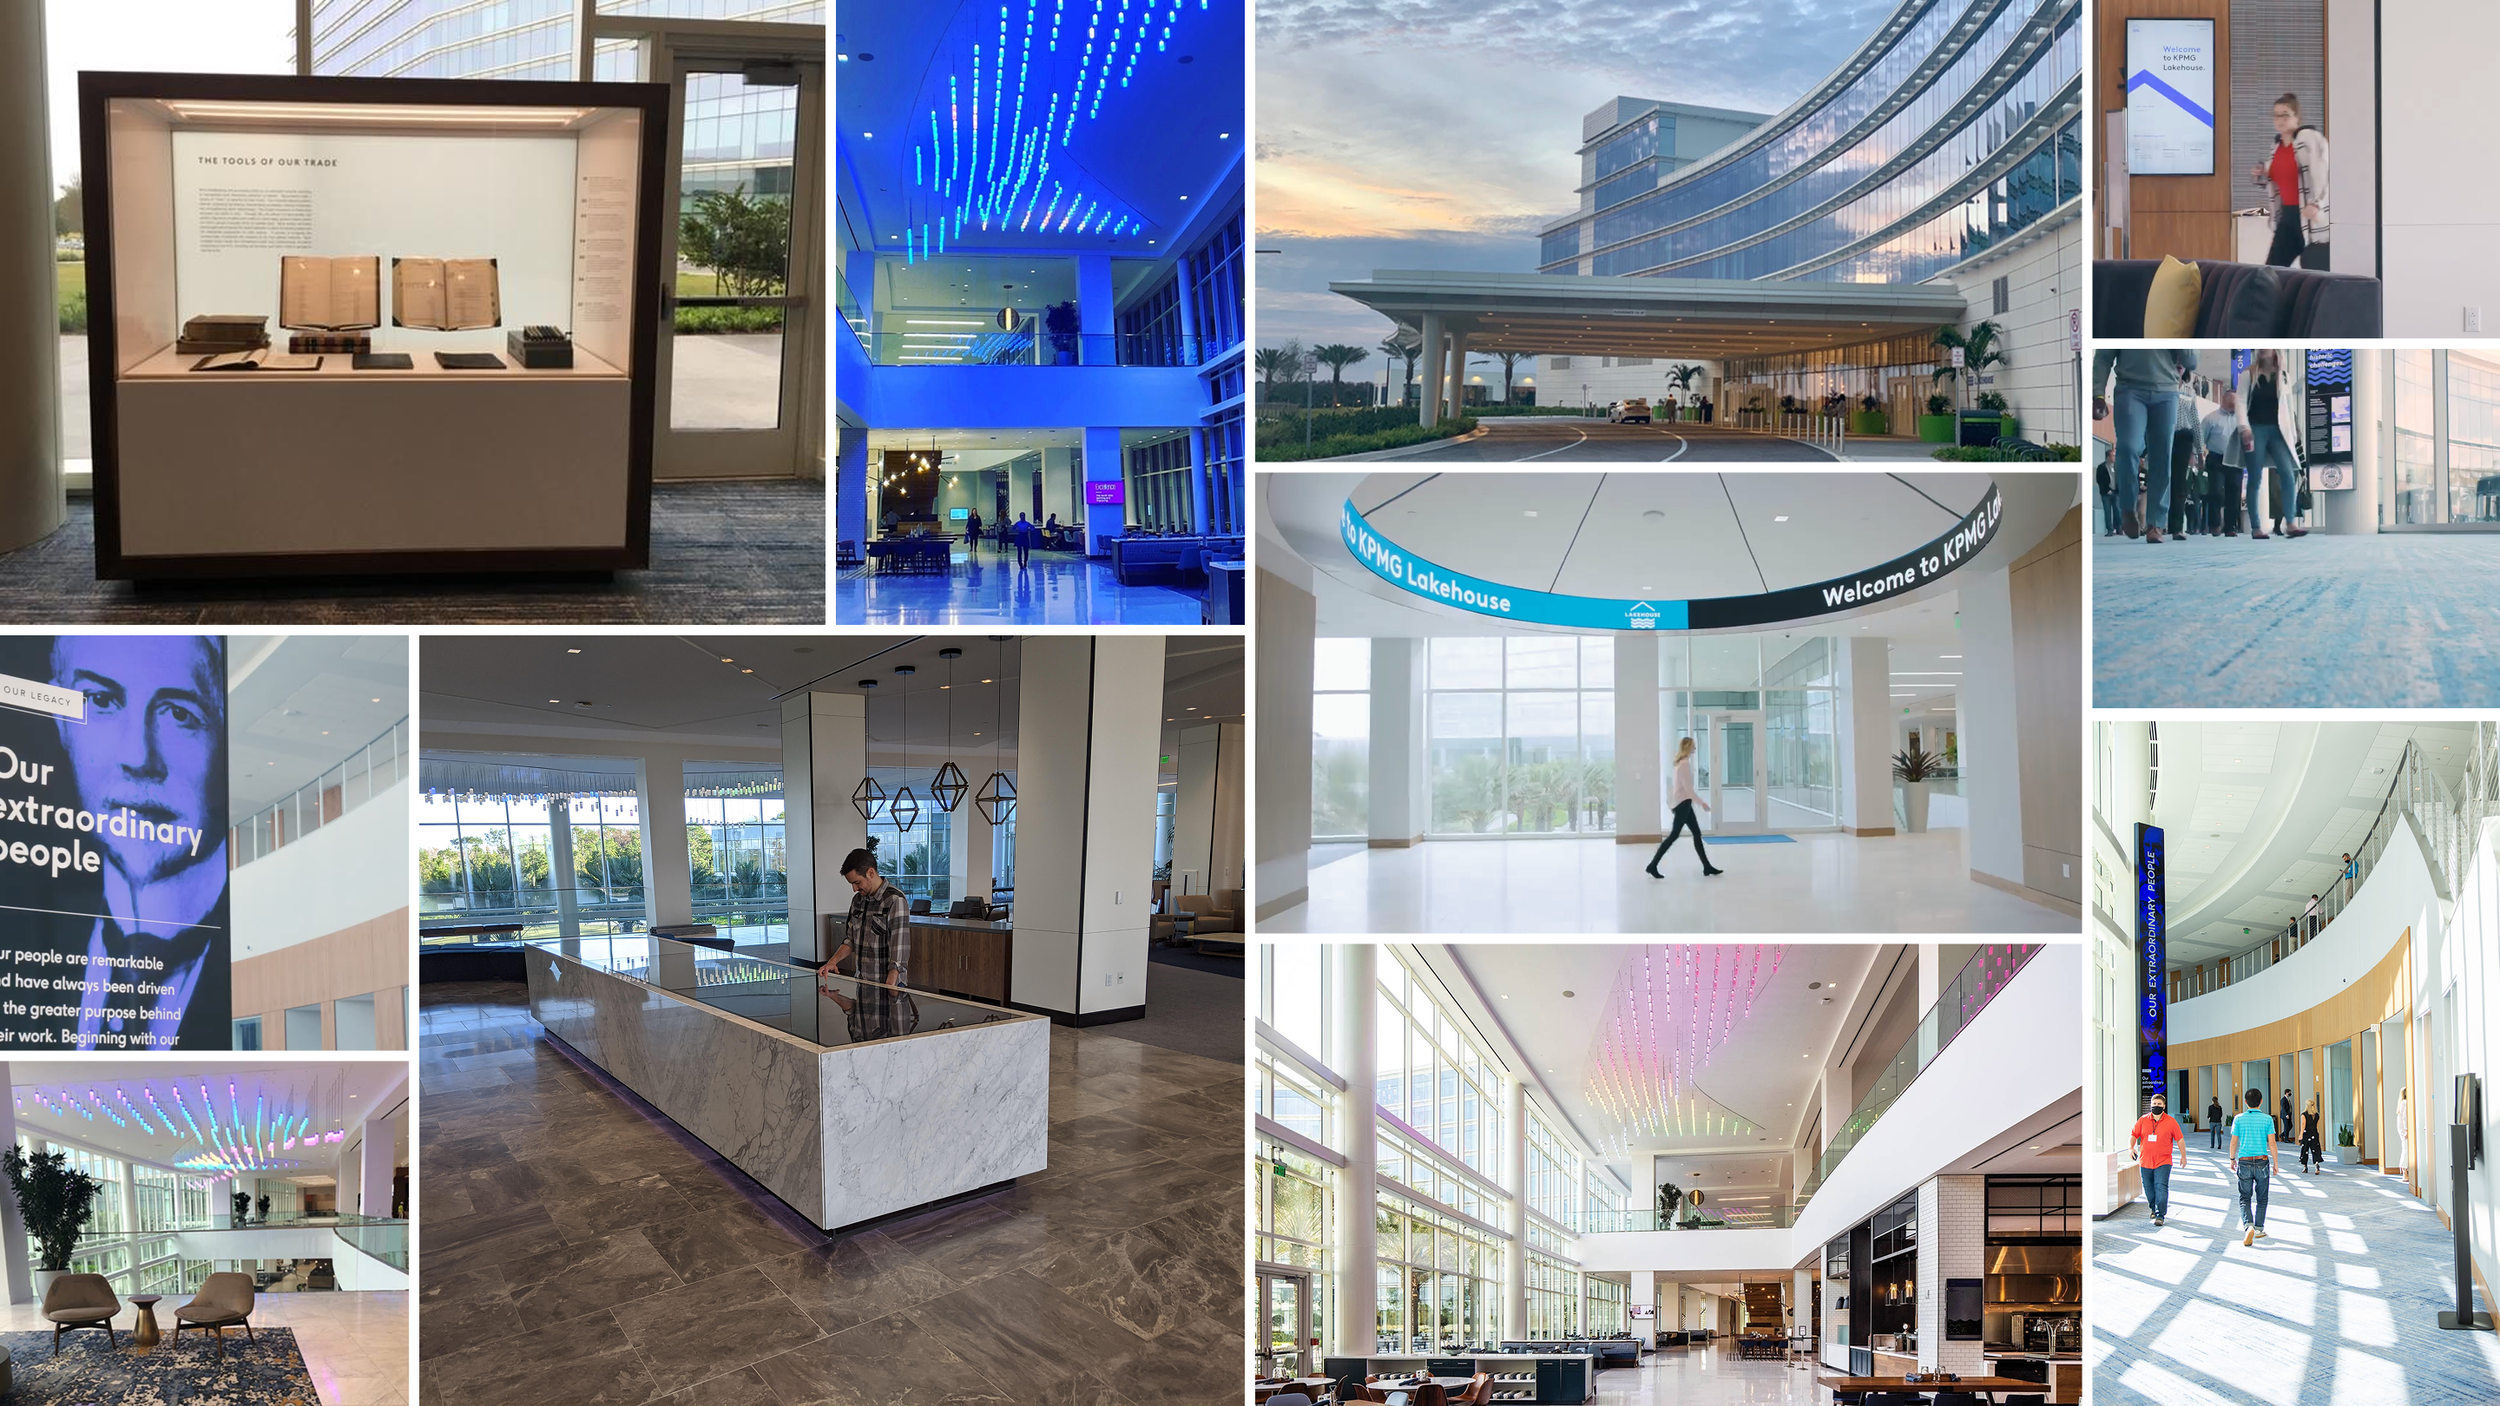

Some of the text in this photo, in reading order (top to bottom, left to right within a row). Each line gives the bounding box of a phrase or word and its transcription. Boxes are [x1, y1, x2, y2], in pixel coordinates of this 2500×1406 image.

[222, 157, 256, 165] TOOLS
[278, 158, 300, 166] OUR
[304, 159, 337, 167] TRADE
[1346, 511, 1356, 544] to
[1359, 526, 1402, 578] KPMG
[1408, 562, 1511, 612] Lakehouse
[1822, 566, 1915, 607] Welcome
[1920, 556, 1939, 577] to
[1944, 511, 1986, 566] KPMG
[4, 686, 71, 706] OUR LEGACY
[0, 746, 54, 785] Our
[2148, 896, 2156, 988] EXTRAORDINARY
[15, 949, 63, 966] people
[66, 954, 88, 965] are
[92, 955, 164, 970] remarkable
[15, 973, 49, 989] have
[53, 976, 99, 995] always
[103, 979, 134, 993] been
[137, 982, 175, 995] driven
[3, 1000, 181, 1022] the greater purpose behind
[2149, 993, 2157, 1017] OUR
[18, 1028, 57, 1043] work.
[62, 1029, 126, 1048] Beginning
[130, 1032, 156, 1045] with
[160, 1036, 179, 1046] our
